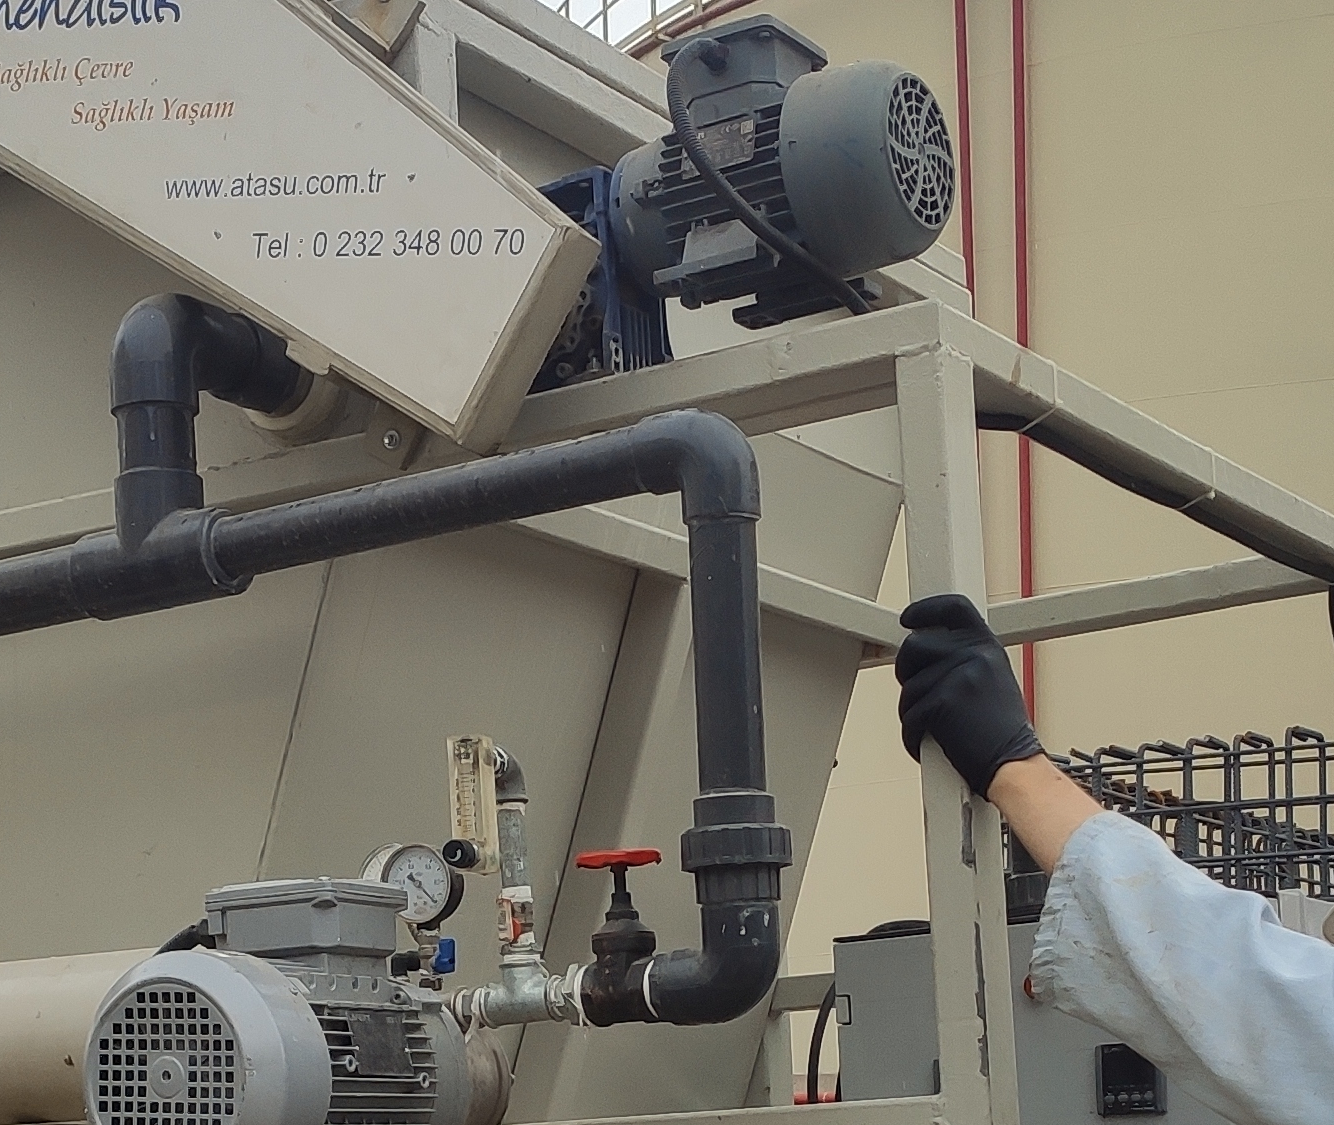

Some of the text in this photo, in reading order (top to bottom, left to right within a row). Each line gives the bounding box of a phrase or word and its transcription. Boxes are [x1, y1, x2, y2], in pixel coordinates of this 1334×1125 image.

[74, 57, 134, 86] Çevre
[71, 98, 235, 131] Sağlıklı Yaşam
[165, 168, 387, 199] www.atasu.com.tr
[252, 232, 289, 259] Tel
[312, 231, 328, 257] 0
[336, 230, 383, 257] 232
[392, 229, 441, 257] 348
[450, 229, 482, 256] 00
[493, 228, 525, 255] 70
